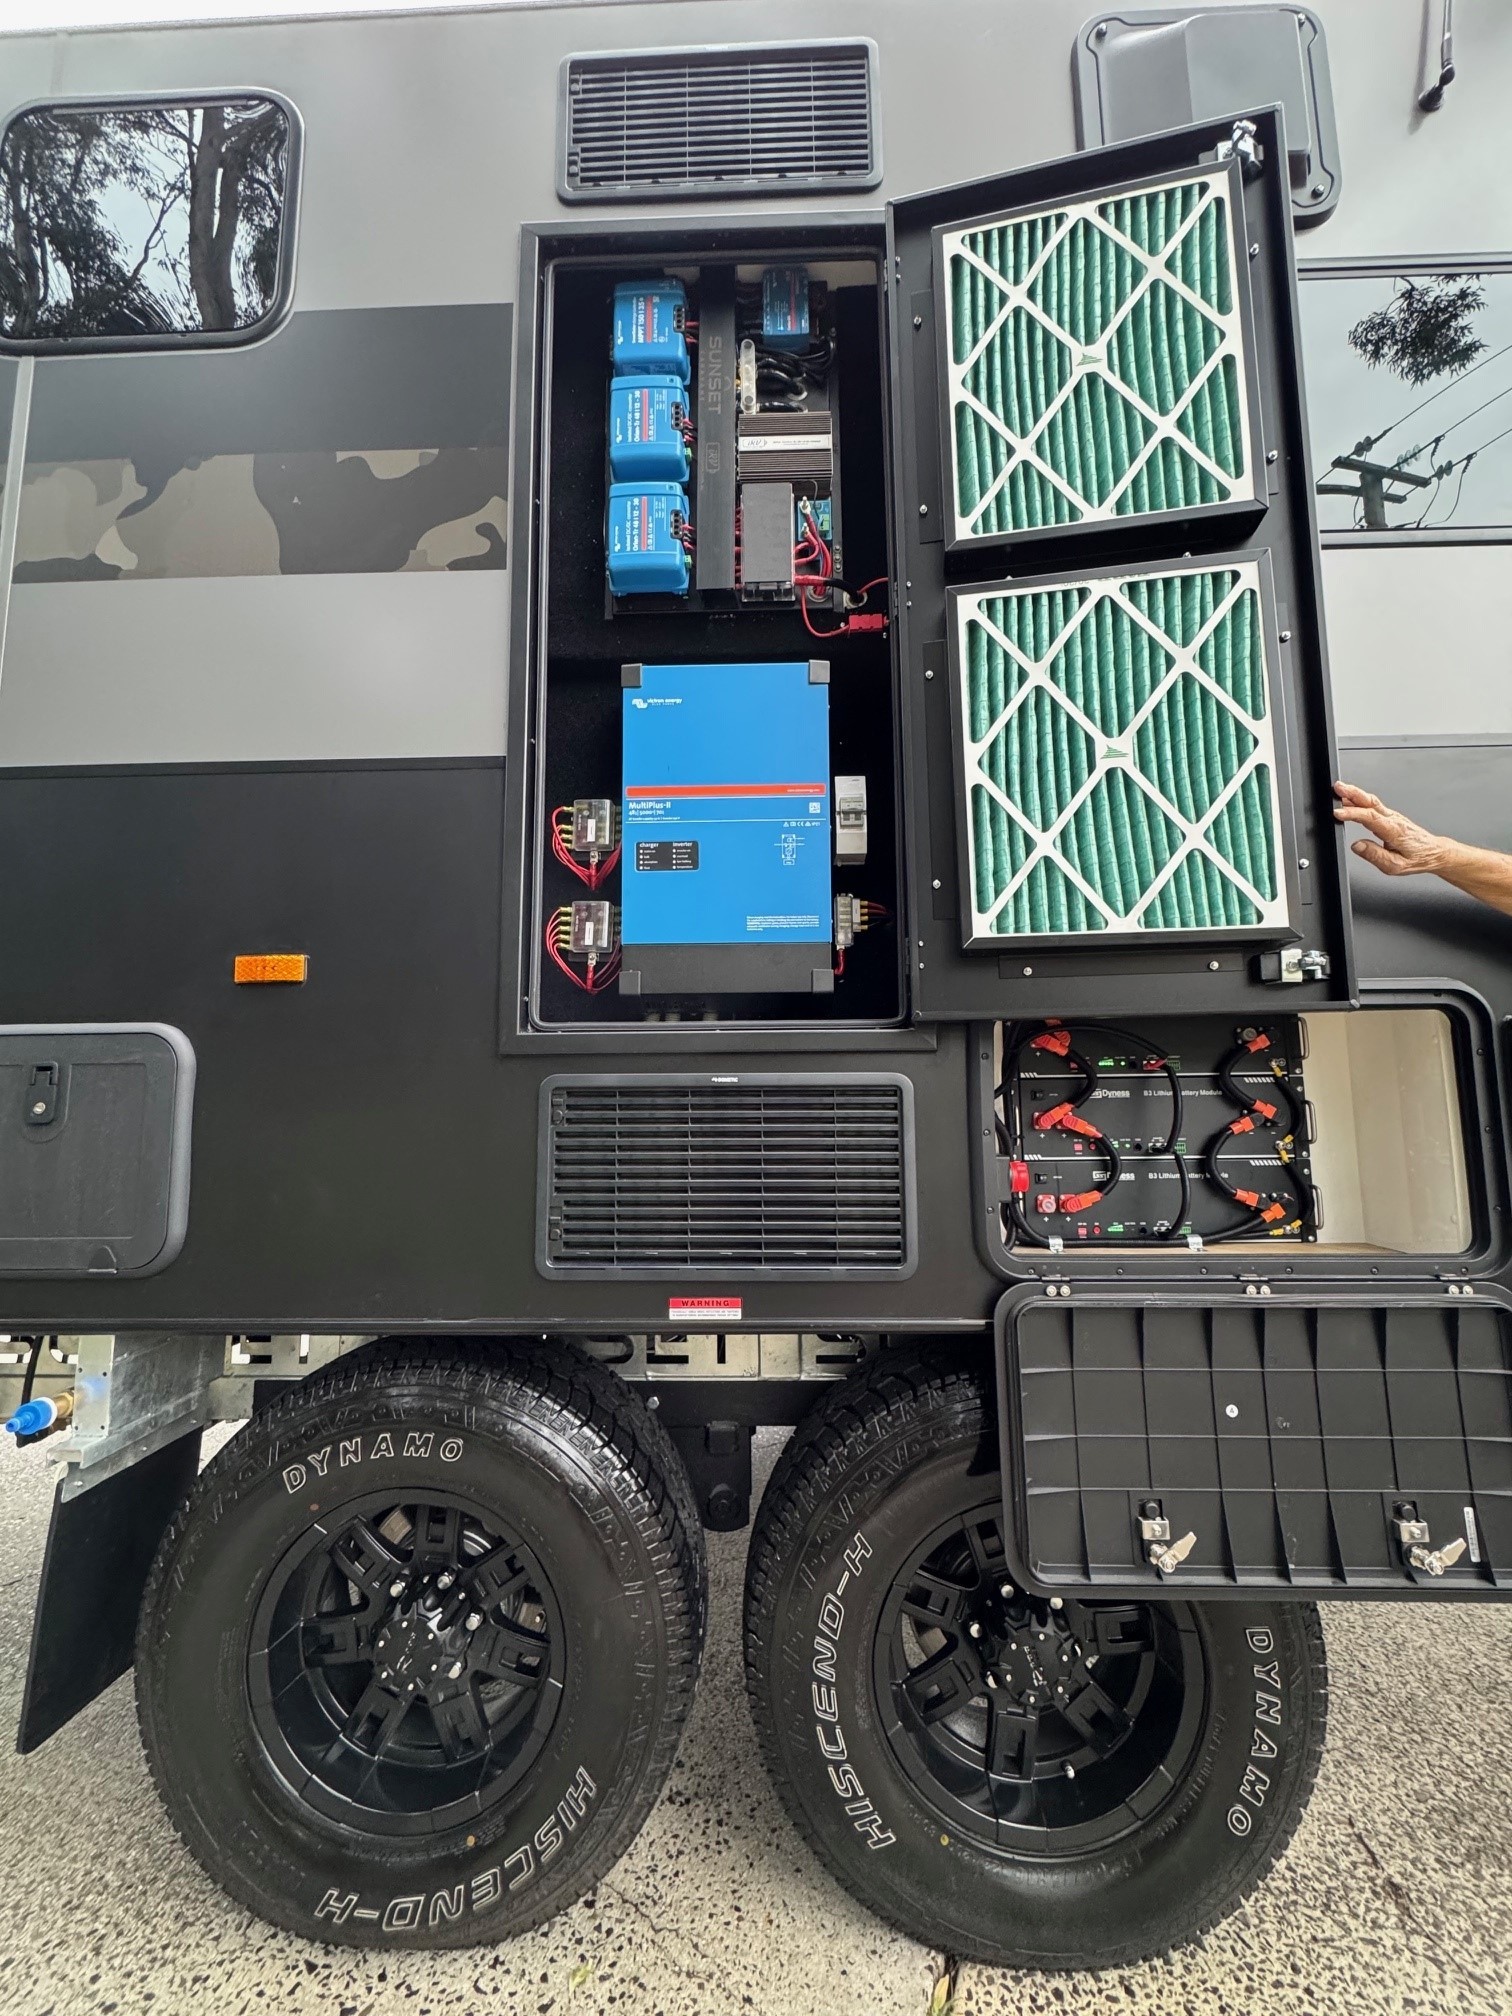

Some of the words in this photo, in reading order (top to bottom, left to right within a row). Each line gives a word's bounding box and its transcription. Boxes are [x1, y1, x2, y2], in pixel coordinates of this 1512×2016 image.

[709, 335, 723, 415] SUNSET
[634, 412, 640, 420] 48
[633, 520, 639, 528] 48
[628, 801, 671, 810] MultiPlus-II
[1102, 1089, 1131, 1098] Dyness
[1181, 1089, 1199, 1098] attery
[1199, 1088, 1223, 1096] Module
[282, 1431, 465, 1494] DYNAMO
[812, 1531, 896, 1850] HISCEND-H
[1226, 1626, 1283, 1837] DYNAMO
[314, 1765, 599, 1931] HISCEND-H
